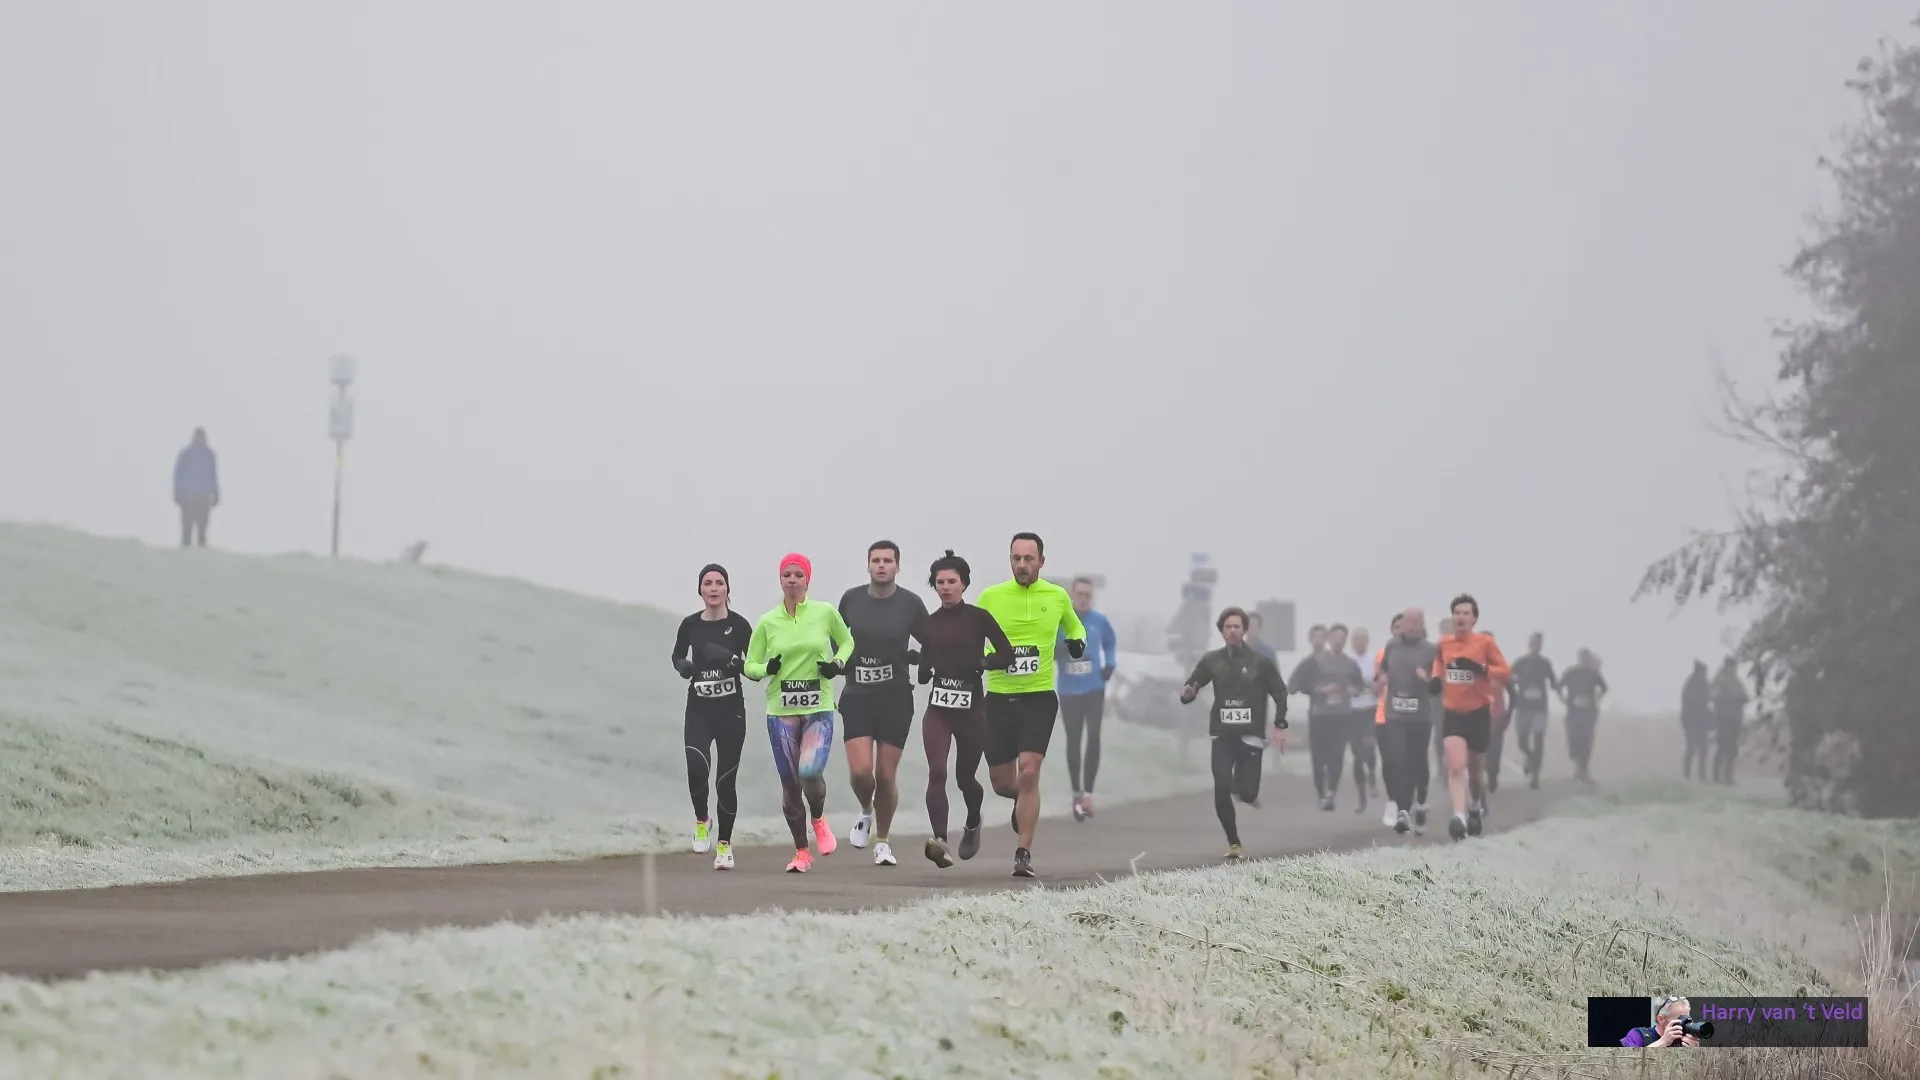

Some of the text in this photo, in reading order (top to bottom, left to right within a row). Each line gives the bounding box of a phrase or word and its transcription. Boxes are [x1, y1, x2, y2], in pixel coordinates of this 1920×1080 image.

[856, 667, 892, 682] 1335
[695, 681, 734, 696] 1380
[781, 694, 820, 707] 1482
[935, 690, 970, 707] 1473
[1221, 710, 1250, 721] 1434
